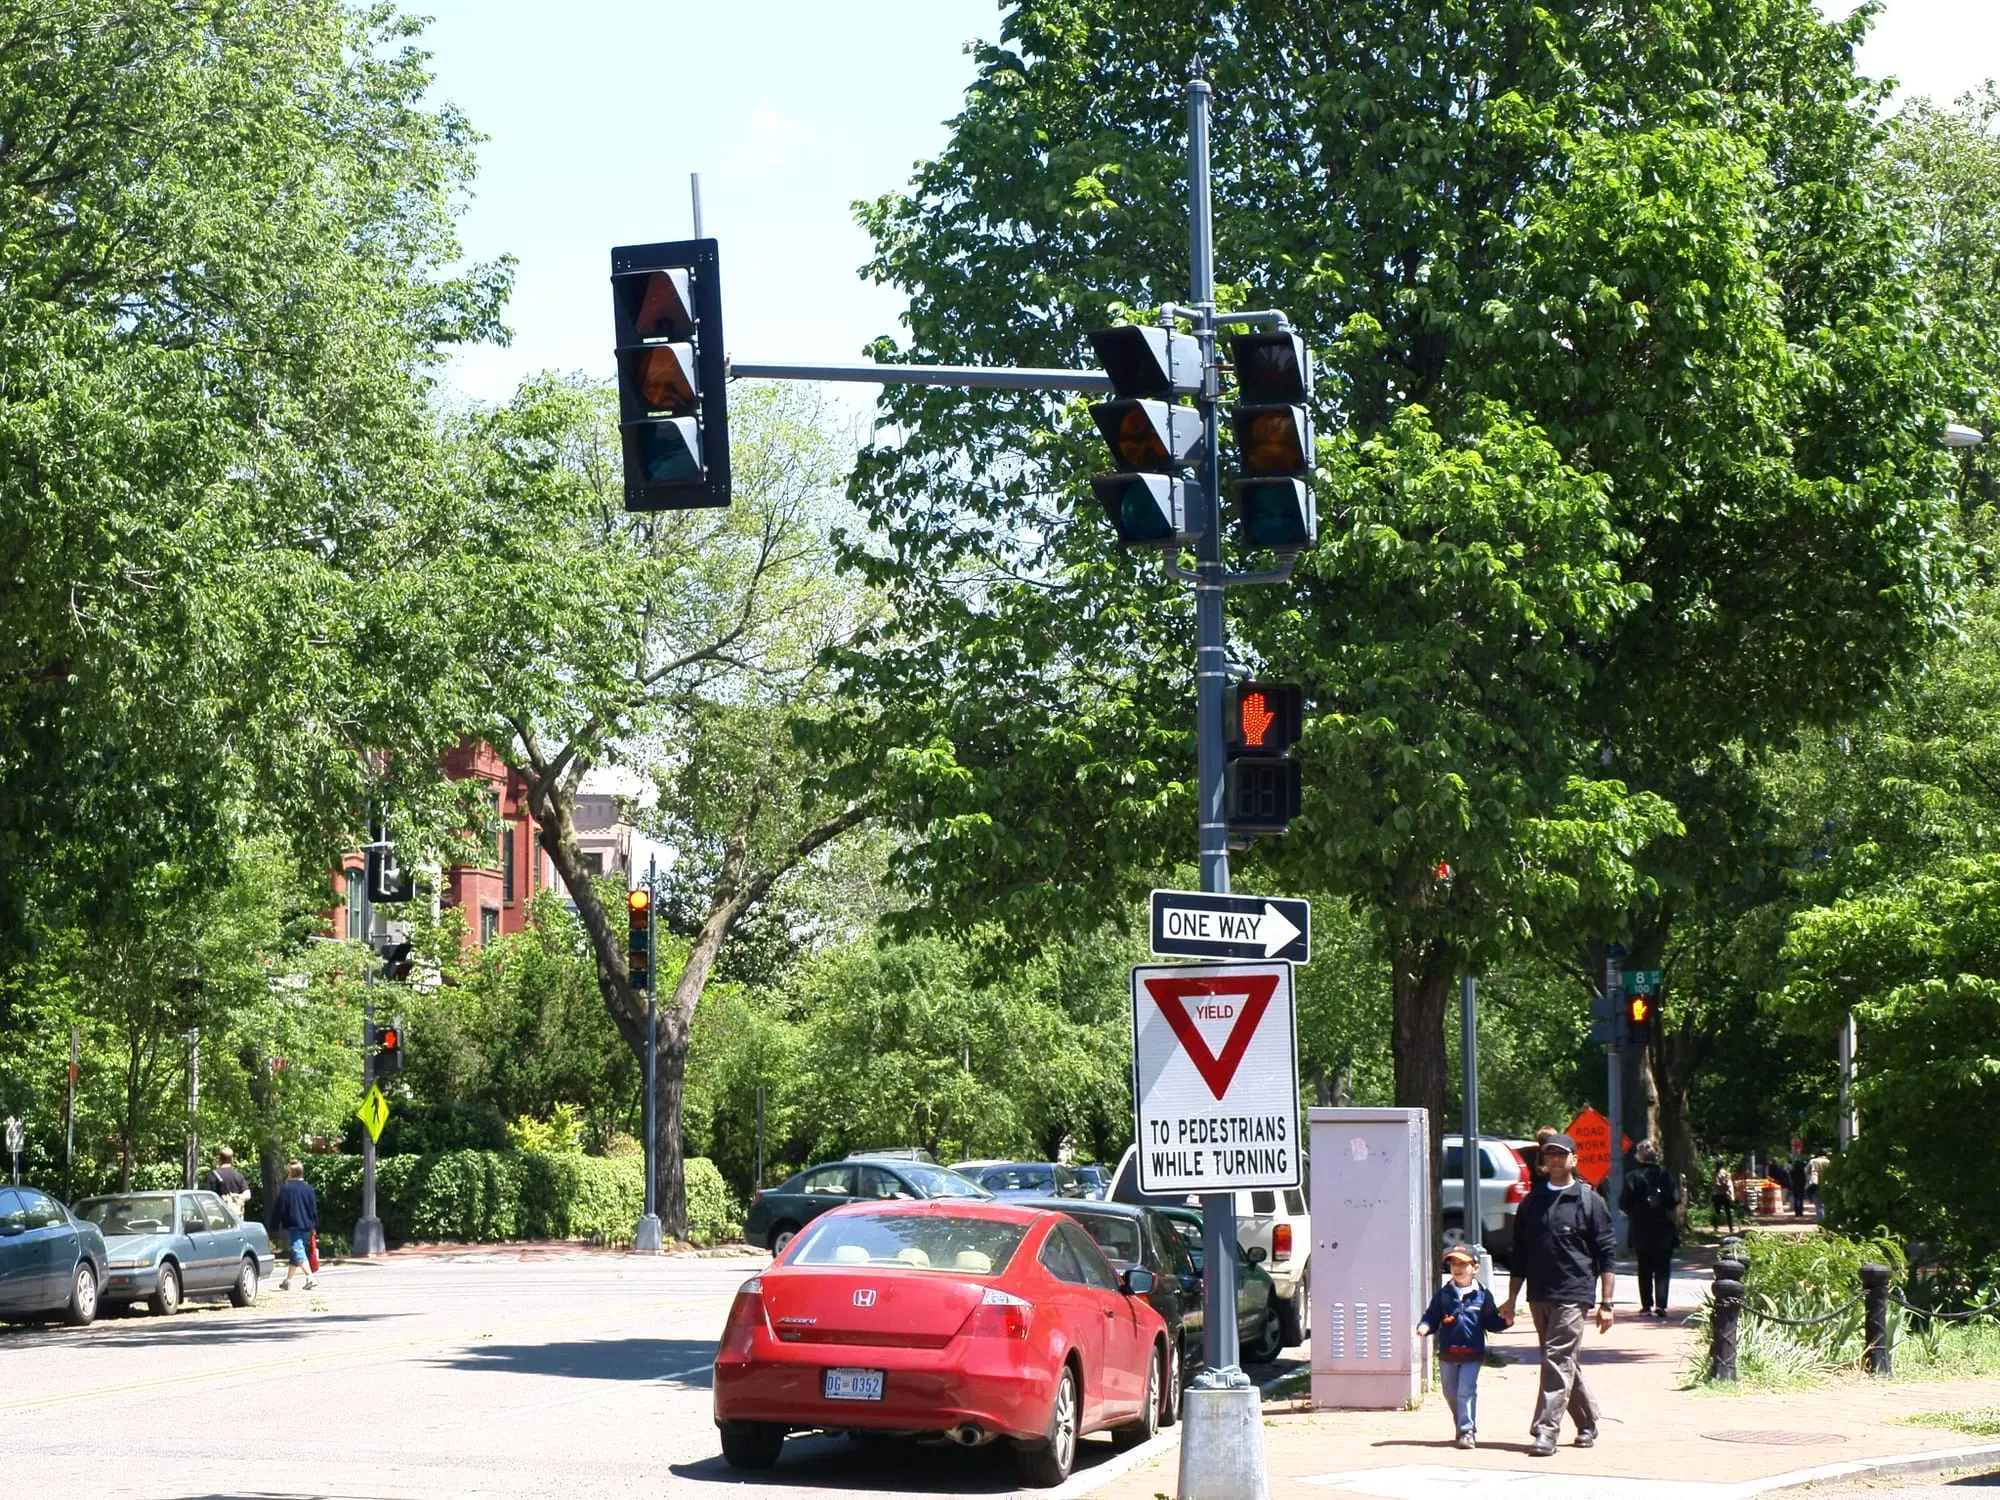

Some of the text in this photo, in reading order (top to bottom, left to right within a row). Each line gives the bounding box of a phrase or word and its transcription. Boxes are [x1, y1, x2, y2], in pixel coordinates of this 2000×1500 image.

[1169, 912, 1262, 940] ONE WAY
[1635, 971, 1645, 984] 8
[1634, 984, 1650, 993] 100
[1196, 1005, 1234, 1019] YIELD
[1150, 1116, 1286, 1145] TO PEDESTRIANS
[1576, 1126, 1605, 1137] ROAD
[1152, 1148, 1287, 1177] WHILE TURNING
[852, 1377, 880, 1393] 0352
